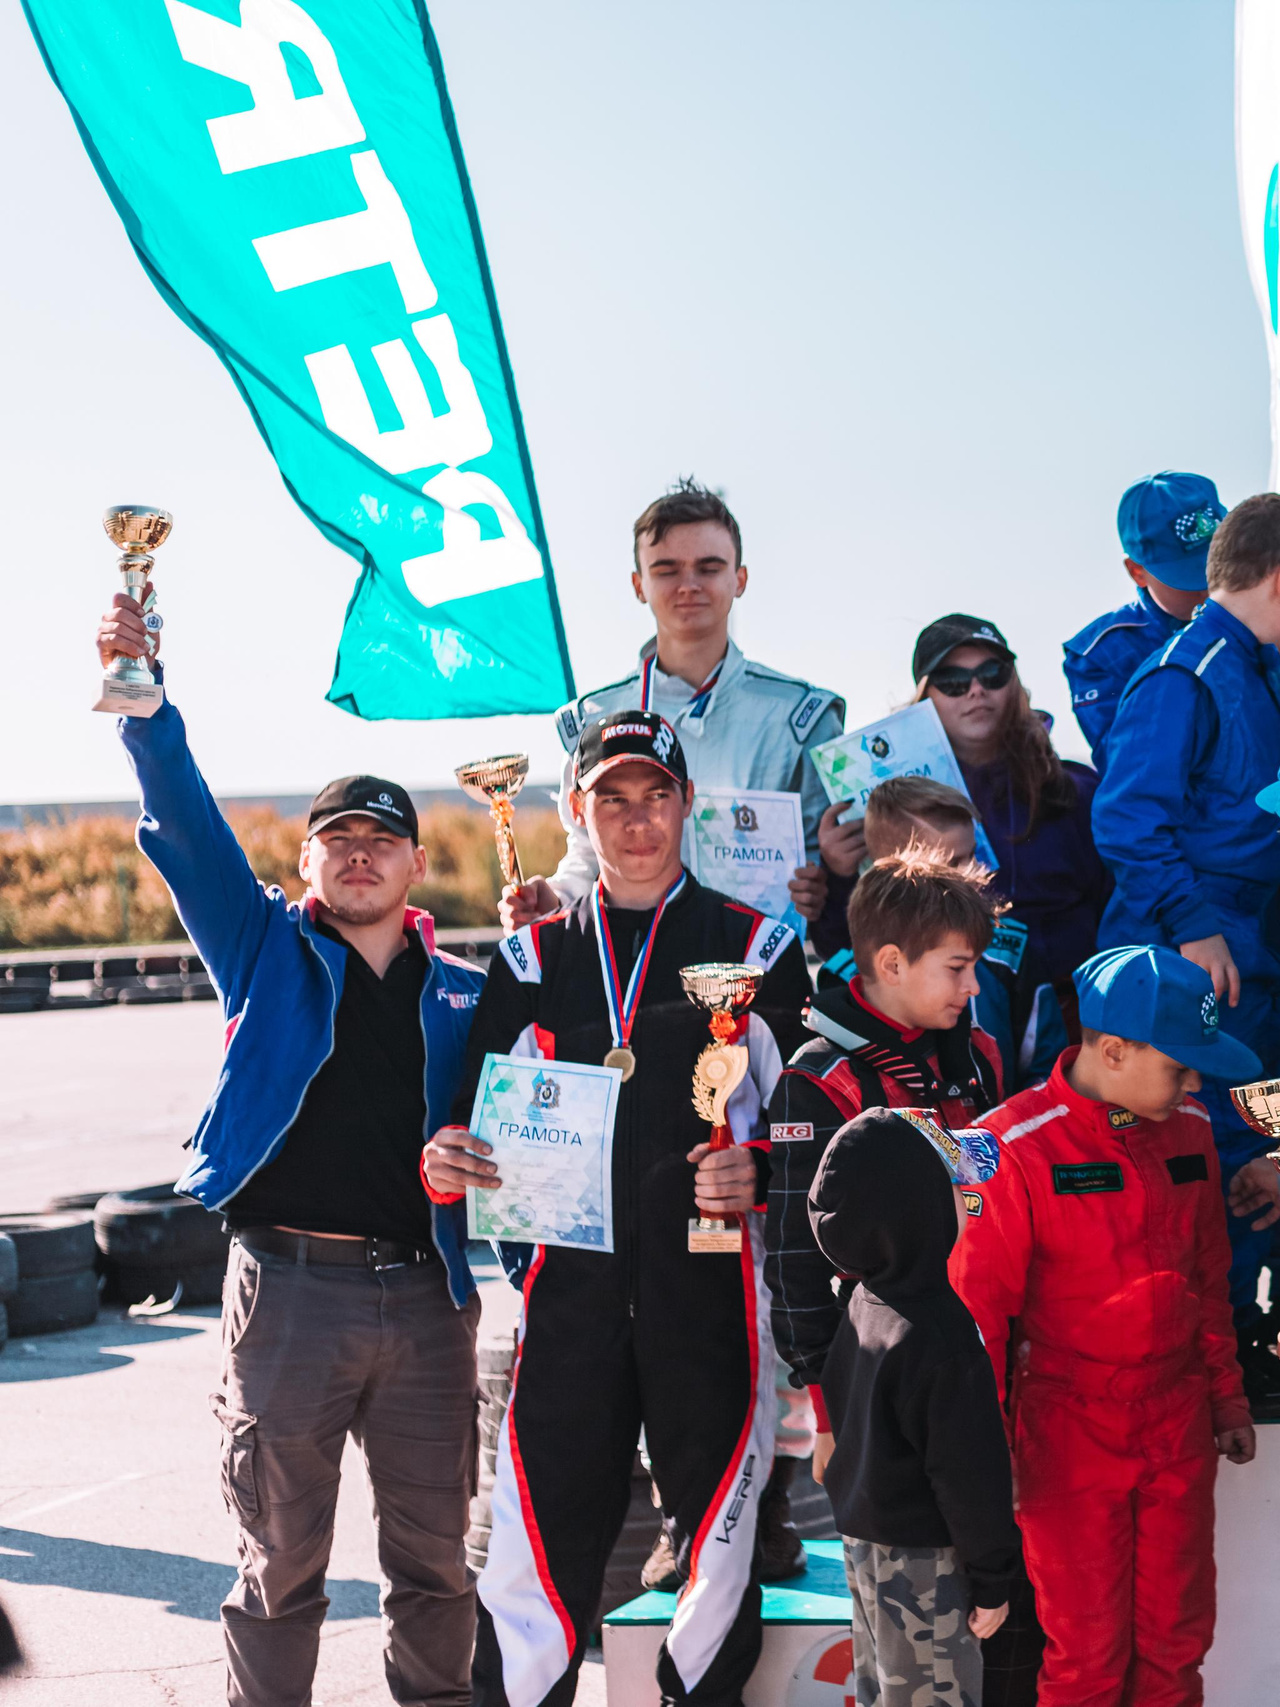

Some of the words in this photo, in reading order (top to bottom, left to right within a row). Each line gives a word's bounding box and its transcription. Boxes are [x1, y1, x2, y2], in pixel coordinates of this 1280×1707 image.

[605, 723, 651, 740] MOTUL
[714, 846, 784, 862] ГРАМОТА
[1112, 1112, 1135, 1126] OMP
[498, 1122, 582, 1146] ГРАМОТА
[771, 1125, 809, 1139] RLG
[963, 1195, 980, 1210] MP
